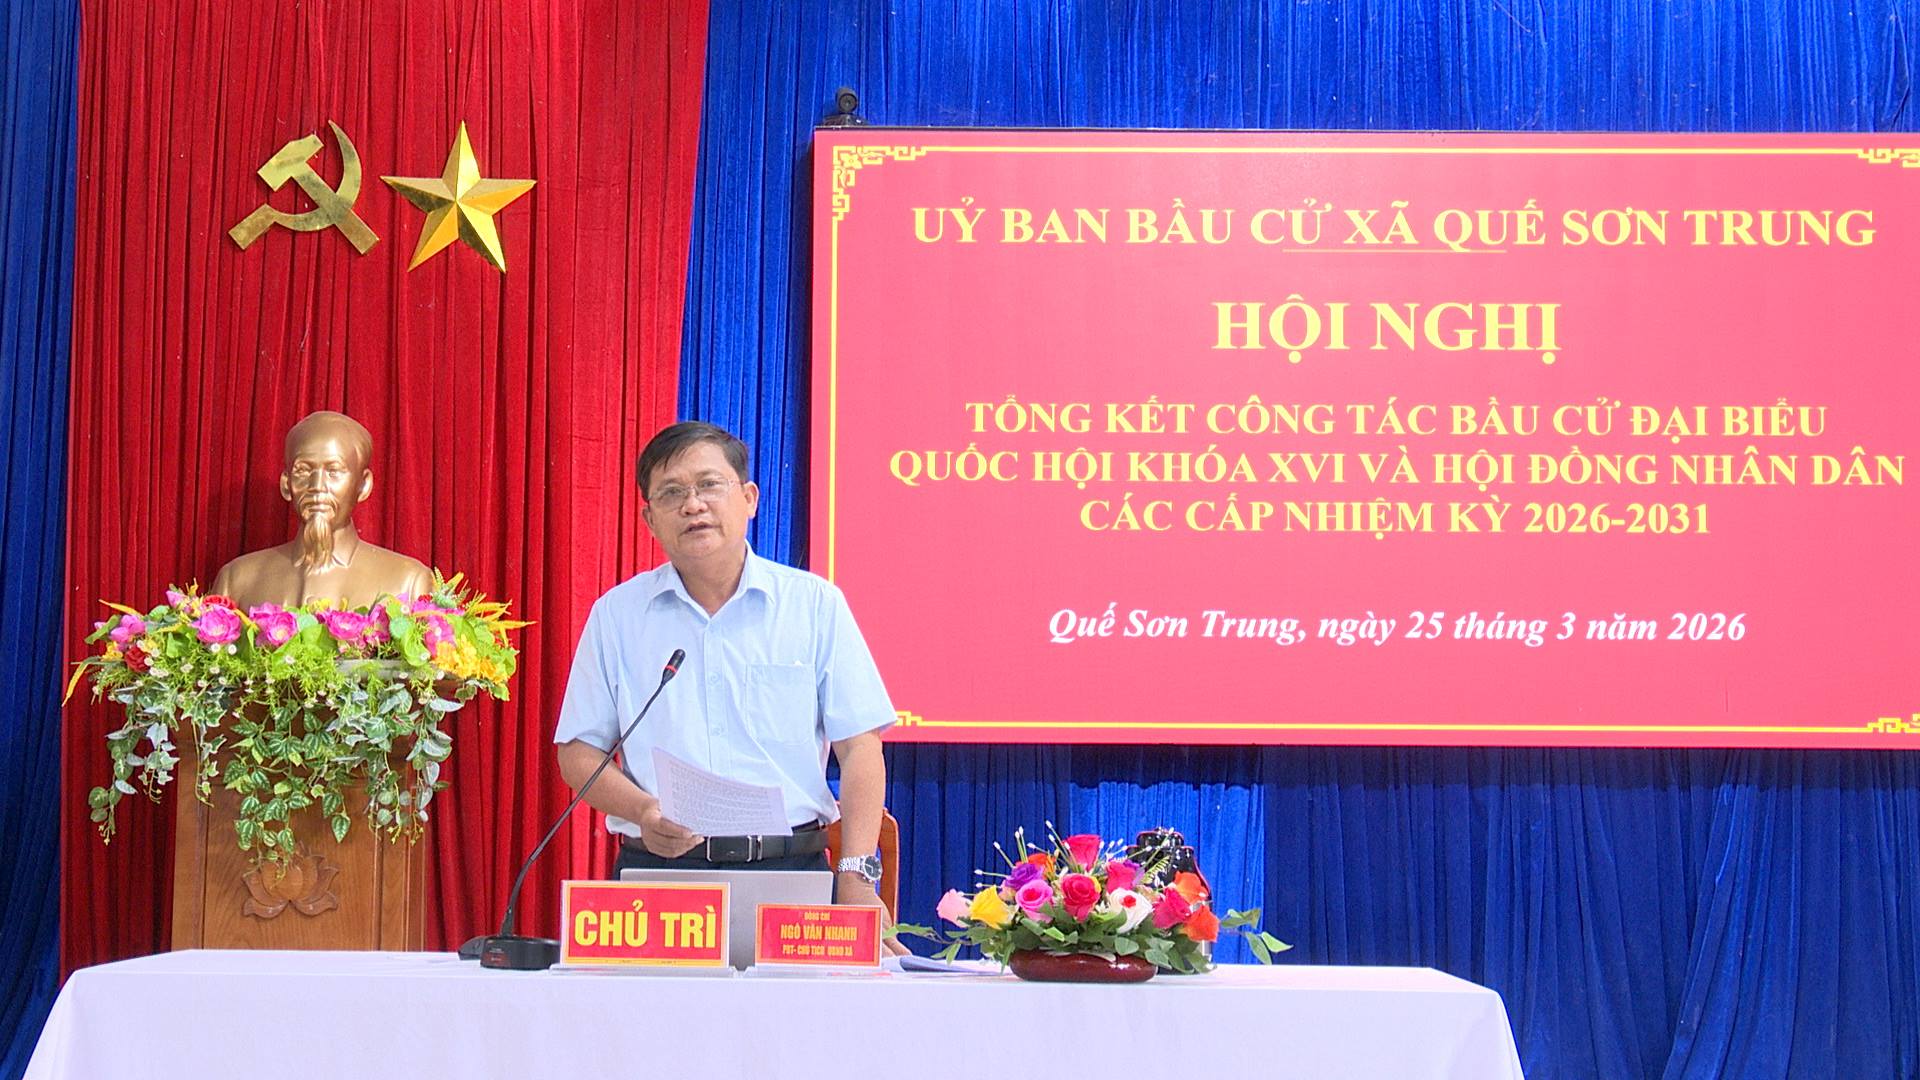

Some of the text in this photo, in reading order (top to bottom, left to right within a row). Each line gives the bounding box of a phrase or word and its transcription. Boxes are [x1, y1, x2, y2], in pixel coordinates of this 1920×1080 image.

[912, 197, 1877, 253] UỶ BAN BẦU CỬ XÃ QUẾ SƠN TRUNG
[1211, 293, 1563, 366] HỘI NGHỊ
[966, 395, 1827, 443] TỔNG KẾT CÔNG TÁC BẦU CỬ ĐẠI BIỂU
[891, 443, 1905, 492] QUỐC HỘI KHÓA XVI VÀ HỘI ĐỒNG NHÂN DÂN
[1081, 493, 1709, 541] CÁC CẤP NHIỆM KỲ 2026-2031
[1050, 603, 1746, 648] Quế Sơn Trung, ngày 25 tháng 3 năm 2026
[575, 900, 718, 950] CHỦ TRÌ
[781, 923, 801, 939] NGÔ
